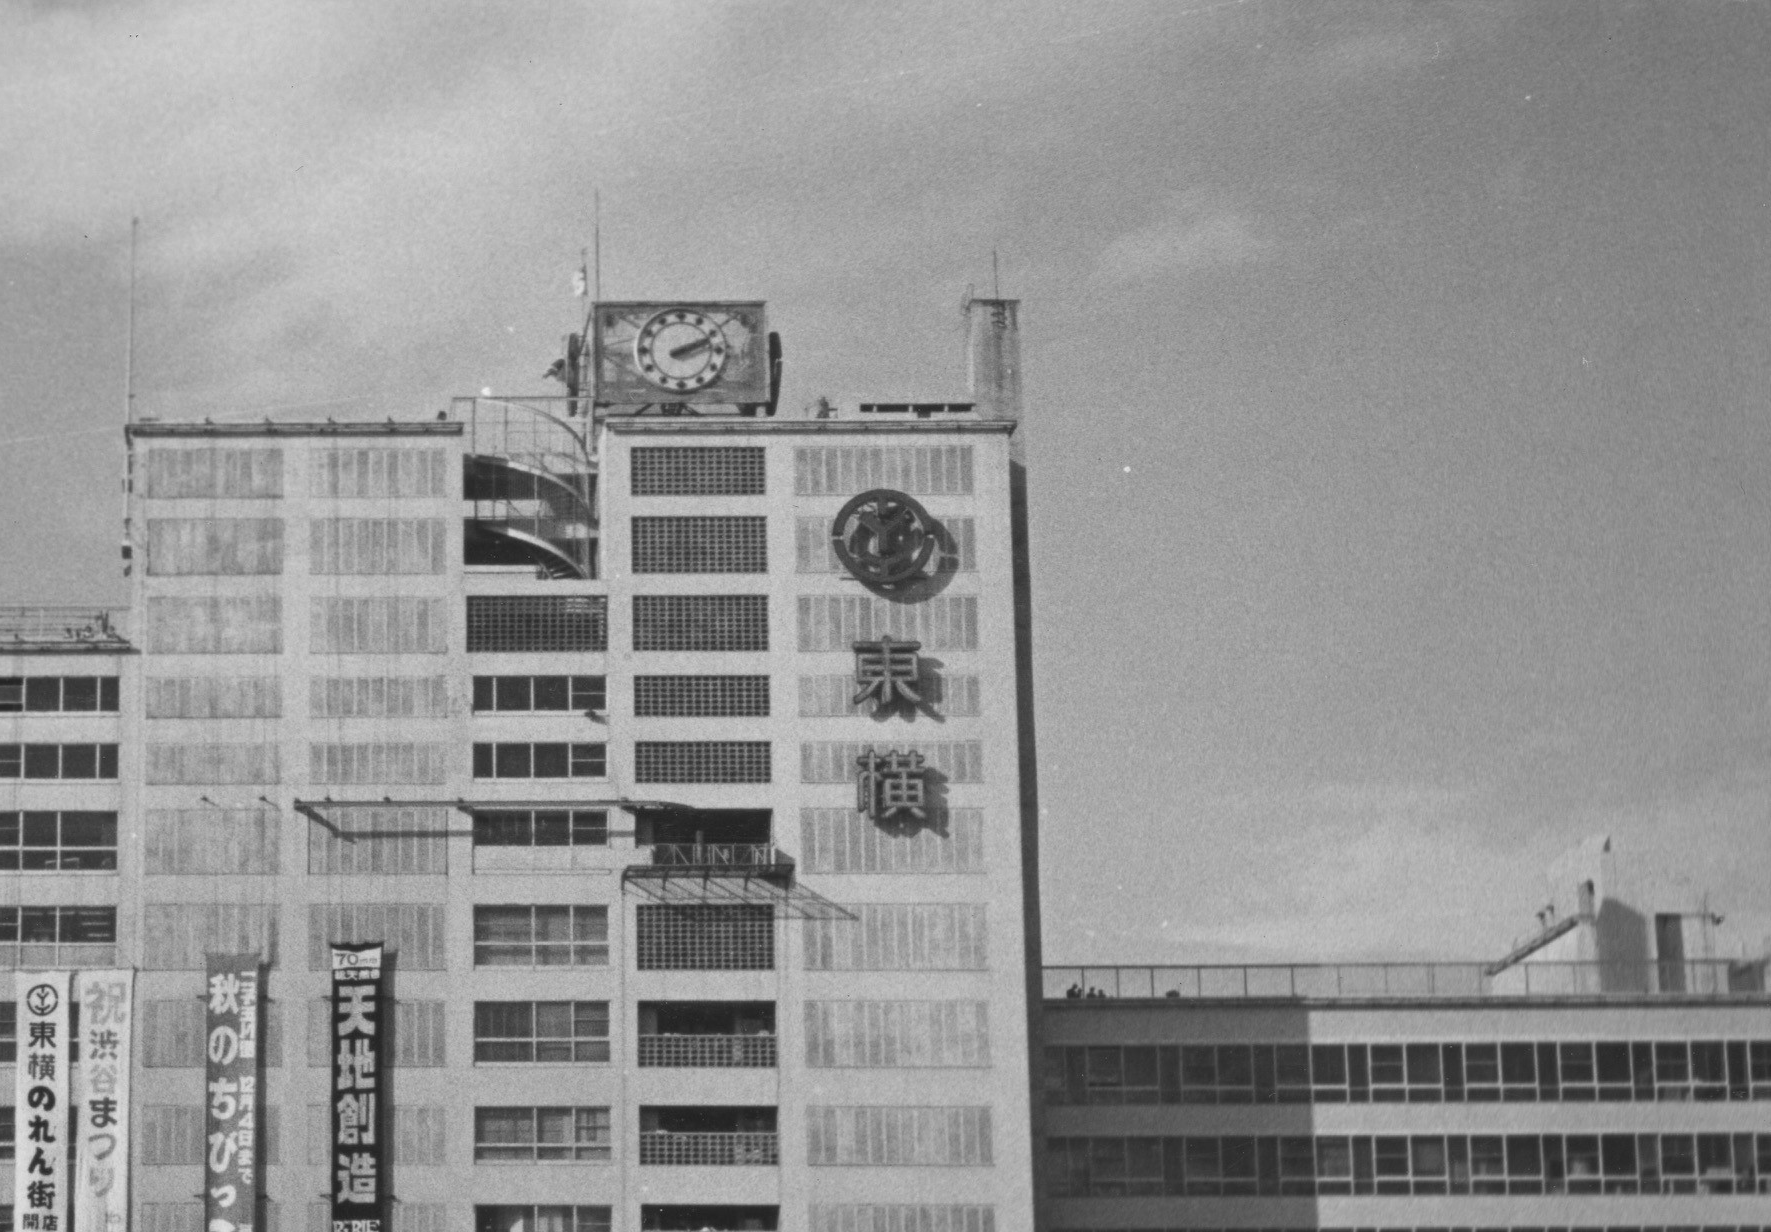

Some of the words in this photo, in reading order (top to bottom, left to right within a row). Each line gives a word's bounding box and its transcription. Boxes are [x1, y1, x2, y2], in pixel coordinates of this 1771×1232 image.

[852, 635, 925, 820] 東横
[337, 985, 377, 1204] 天地創造
